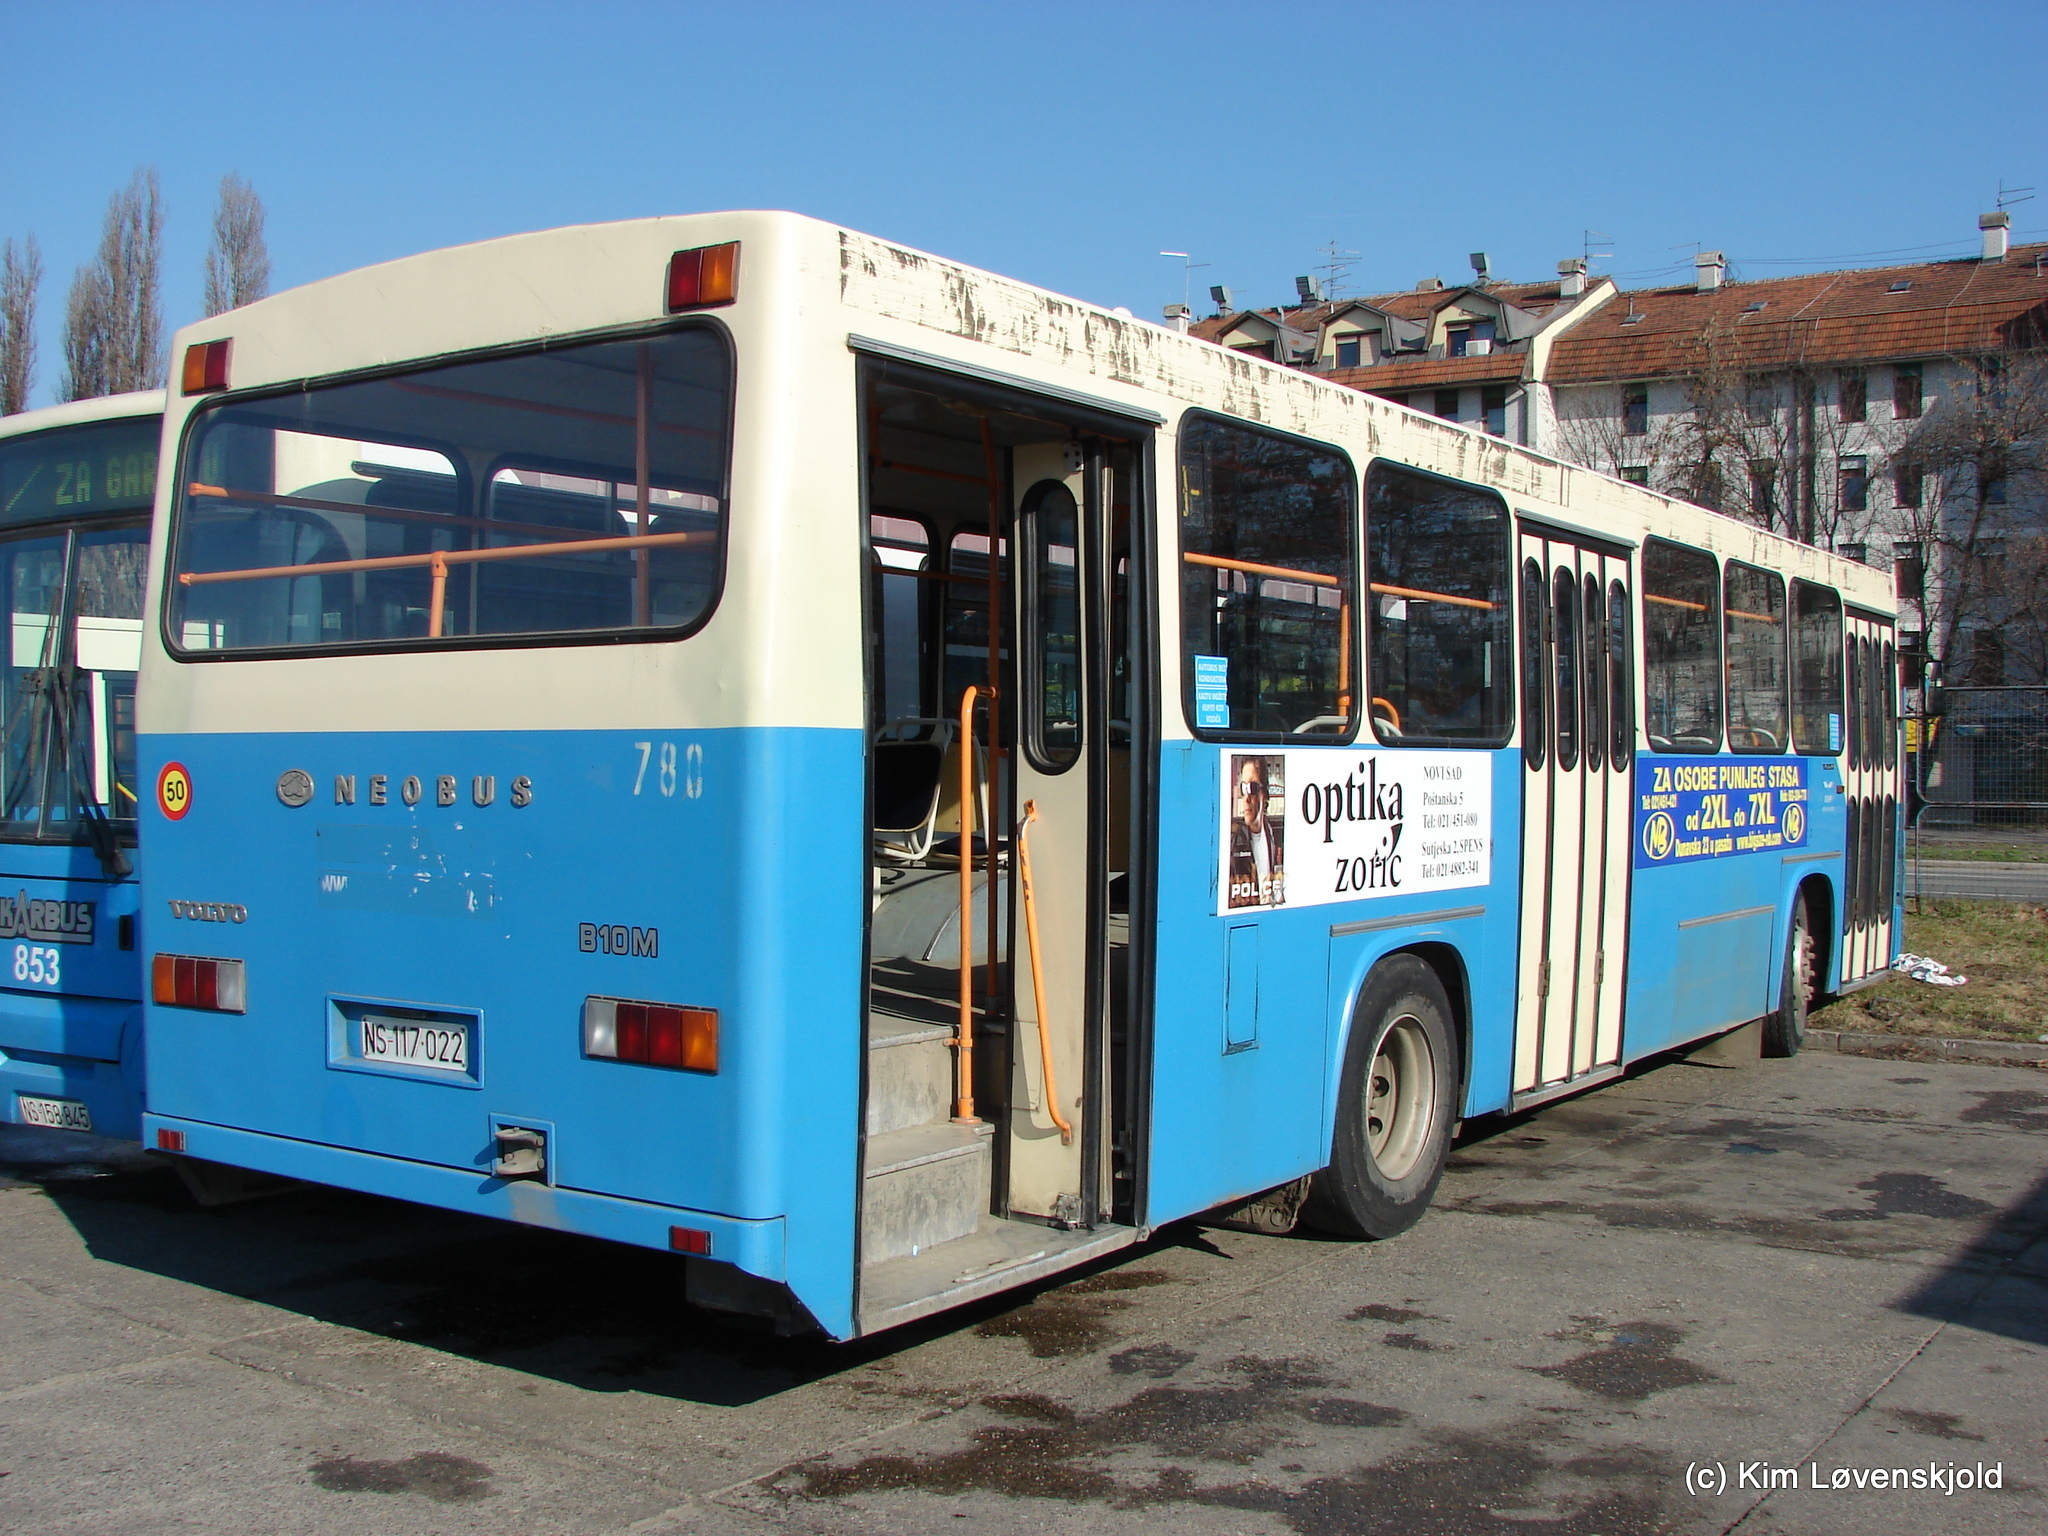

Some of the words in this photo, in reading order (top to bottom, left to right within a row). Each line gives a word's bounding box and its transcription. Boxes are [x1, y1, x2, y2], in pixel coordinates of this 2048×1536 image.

[56, 461, 91, 505] ZA
[633, 741, 703, 799] 780
[1423, 765, 1445, 781] NOVI
[1446, 765, 1463, 781] SAD
[1653, 766, 1672, 793] ZA
[1674, 766, 1717, 792] OSOBE
[1719, 766, 1765, 790] PUNIJEG
[1767, 765, 1799, 788] STASA
[166, 779, 185, 802] 50
[334, 774, 533, 808] NEOBUS
[1302, 757, 1404, 843] optika
[1423, 791, 1457, 806] Poštanska
[1459, 791, 1464, 806] 5
[1423, 814, 1436, 829] Tel:
[1437, 812, 1478, 828] 021/451-080
[1685, 810, 1699, 832] od
[1700, 794, 1731, 830] 2XL
[1733, 807, 1746, 828] do
[1748, 792, 1777, 826] 7XL
[1421, 841, 1452, 860] Sutjeska
[1702, 836, 1710, 854] 23
[1422, 864, 1435, 879] Tel:
[1436, 860, 1480, 877] 021/4882-341
[1231, 880, 1282, 899] POLICE
[168, 900, 249, 924] VOLVO
[579, 922, 659, 959] B10M
[14, 944, 61, 985] 853
